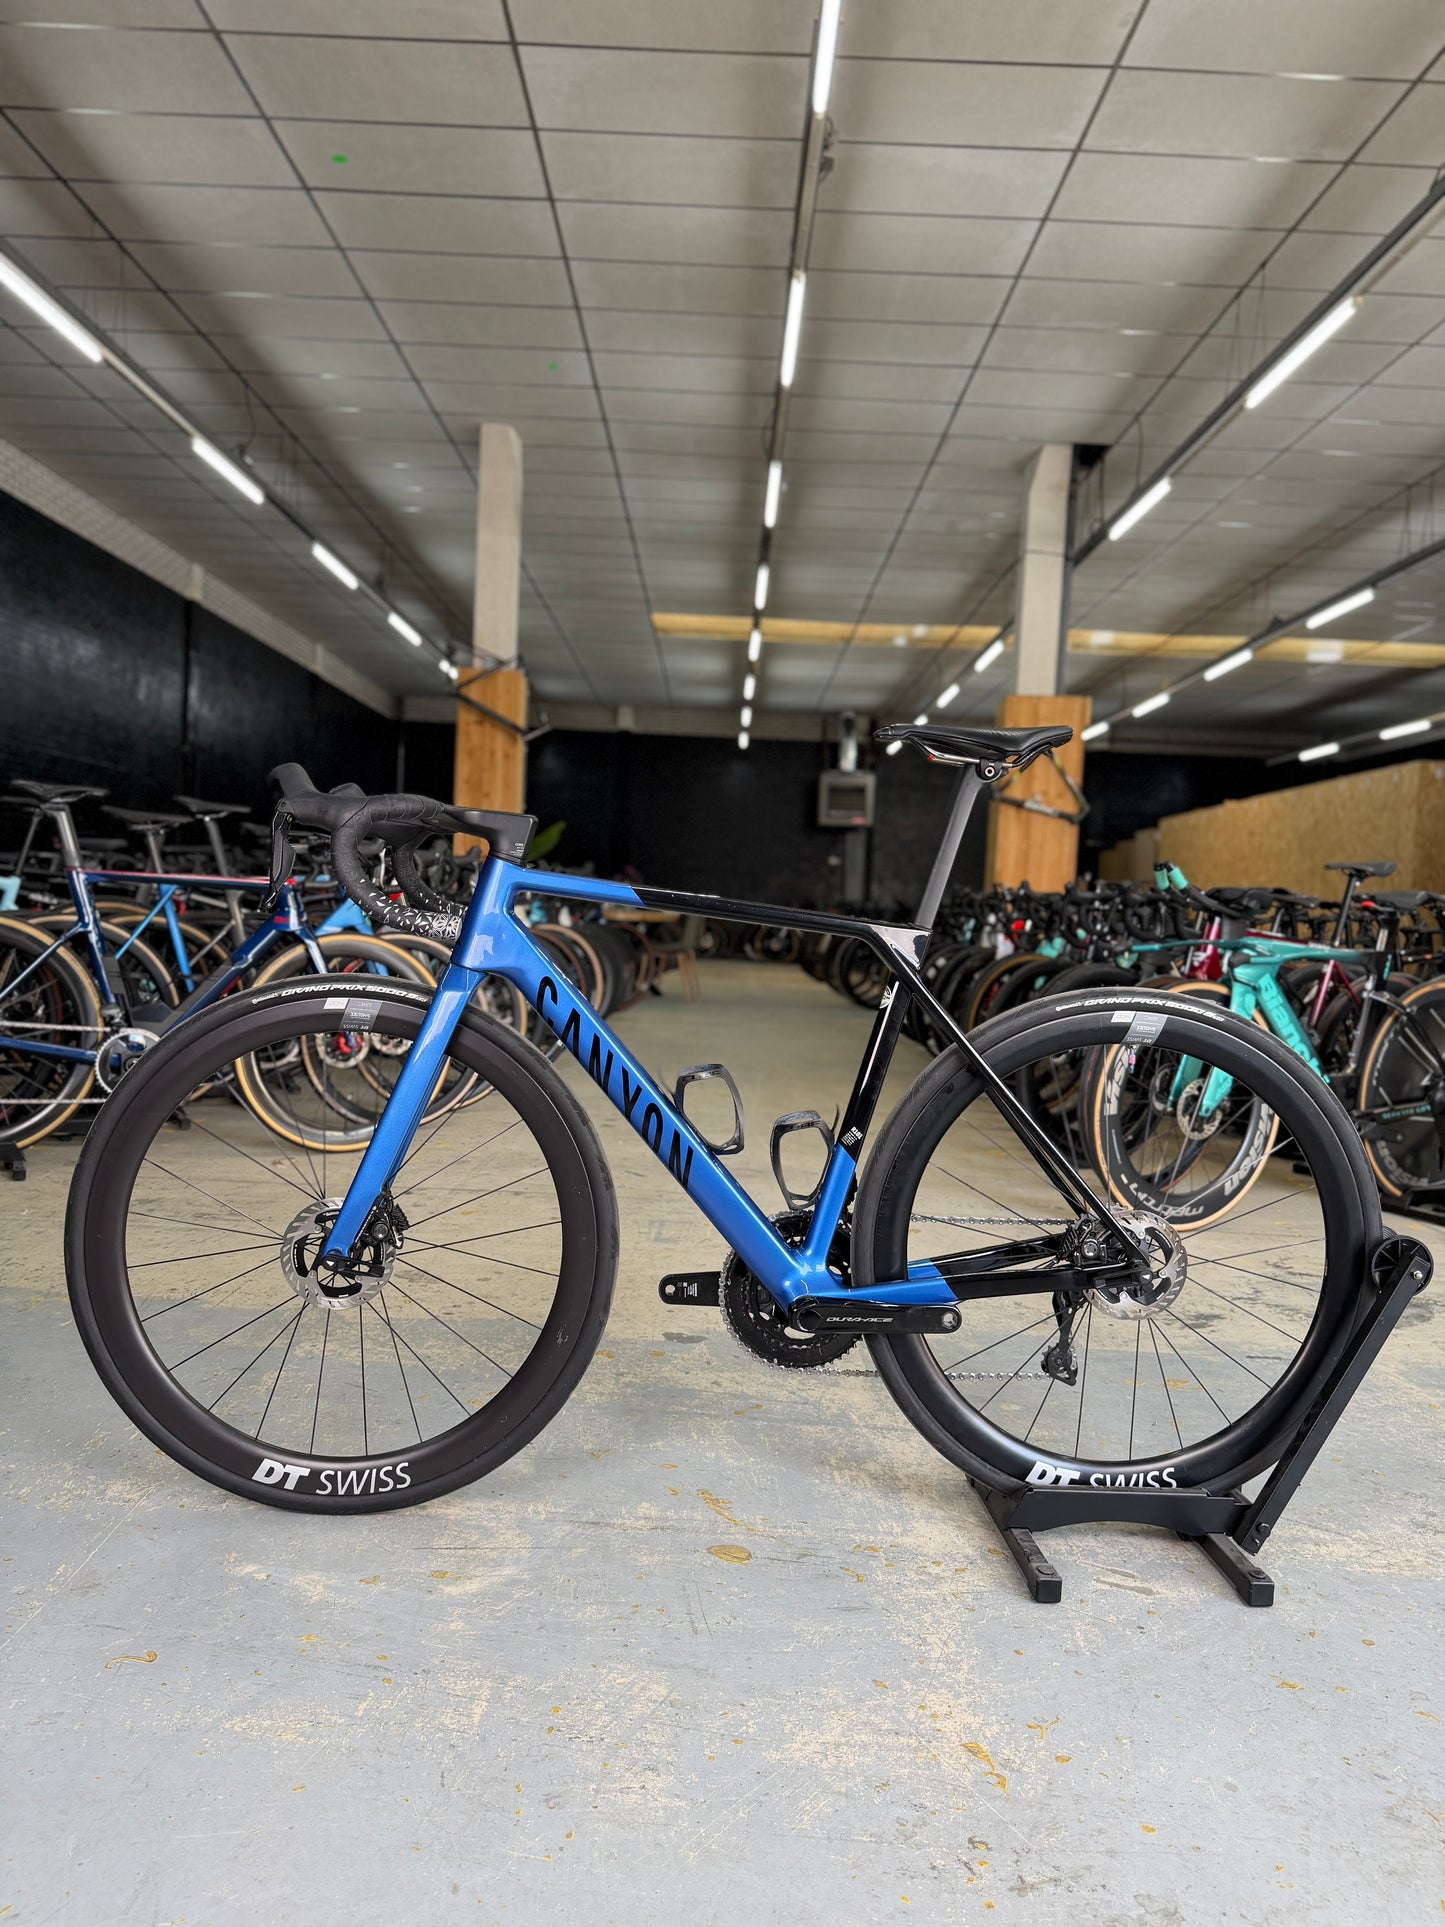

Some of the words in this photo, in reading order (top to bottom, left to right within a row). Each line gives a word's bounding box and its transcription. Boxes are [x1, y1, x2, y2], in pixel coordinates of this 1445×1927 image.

[281, 985, 331, 997] GRAND
[365, 986, 408, 997] 5000
[1084, 997, 1133, 1007] GRAND
[1131, 998, 1167, 1006] PRIX
[1165, 1001, 1206, 1015] 5000
[536, 976, 694, 1190] CANYON
[252, 1458, 311, 1490] DT
[315, 1462, 412, 1496] SWISS
[1025, 1460, 1081, 1487] DT
[1089, 1467, 1178, 1488] SWISS
